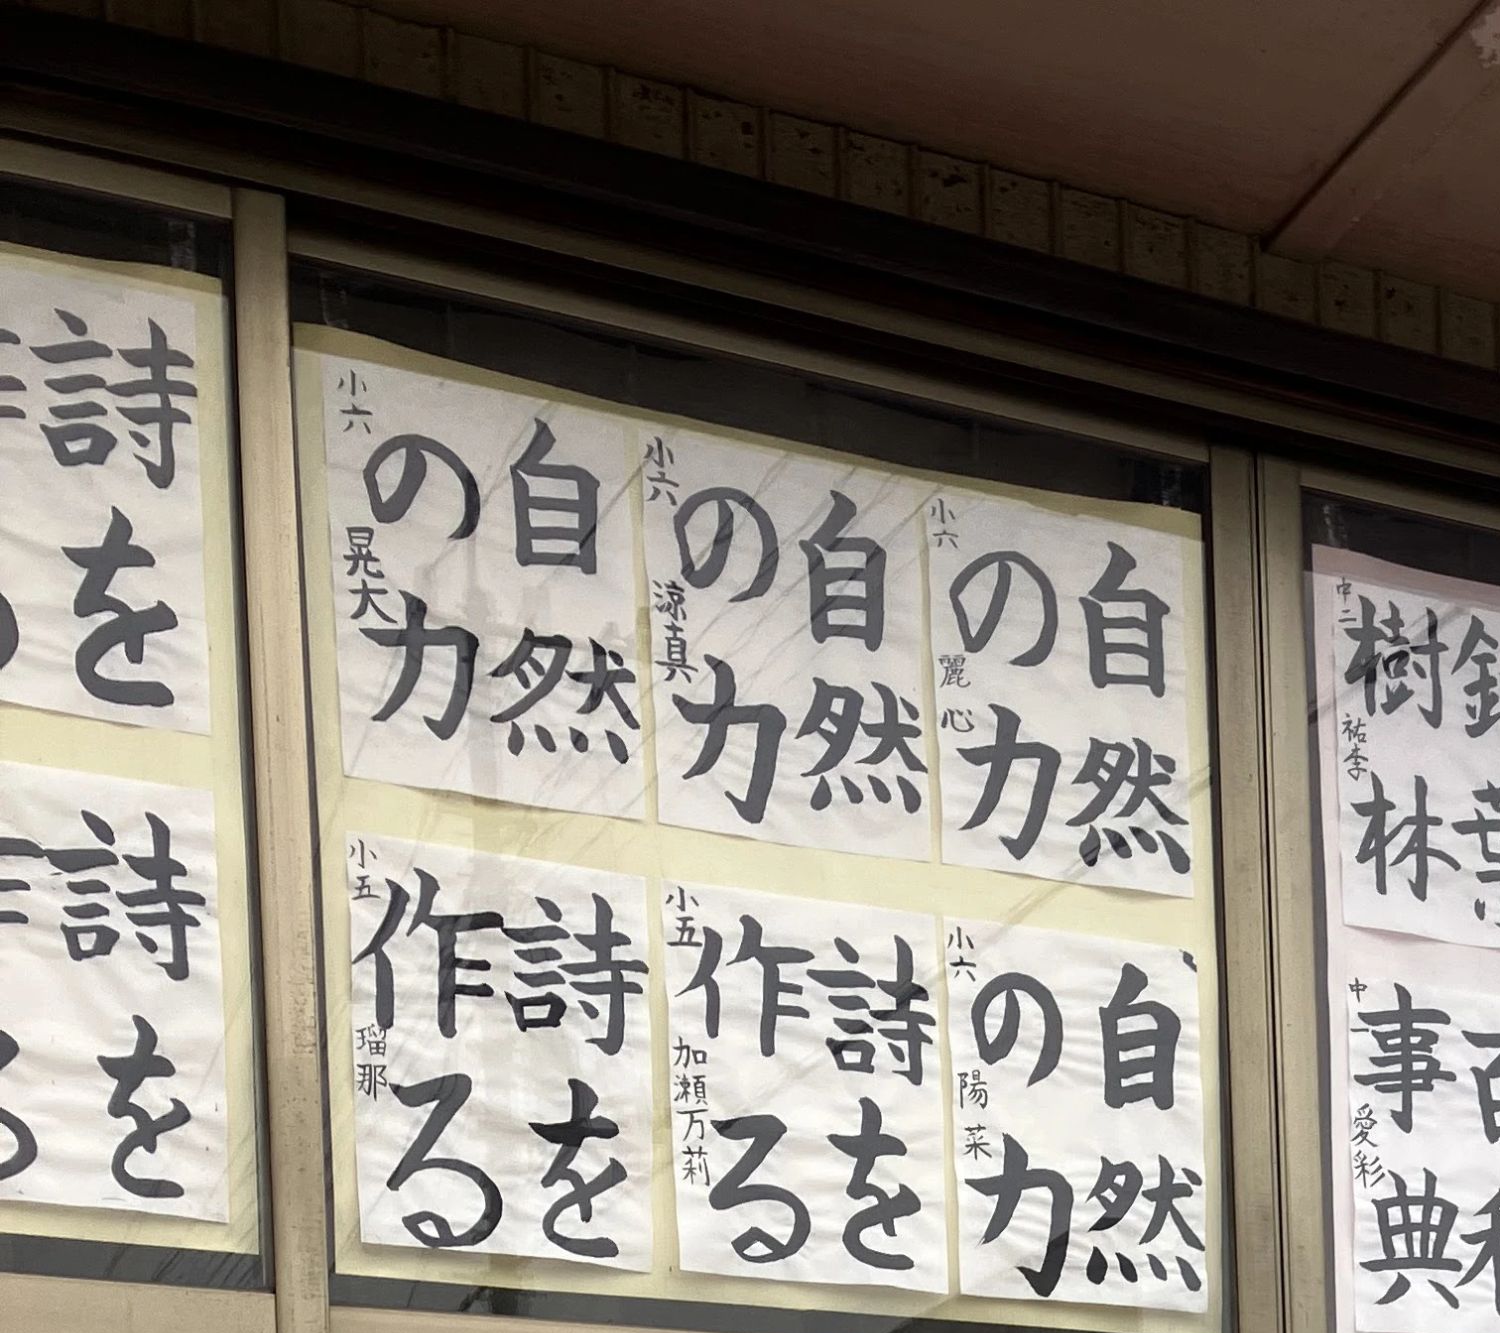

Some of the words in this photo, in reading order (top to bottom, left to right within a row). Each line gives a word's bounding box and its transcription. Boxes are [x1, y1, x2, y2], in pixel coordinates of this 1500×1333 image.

[29, 307, 199, 708] 詩を
[337, 369, 373, 435] 小六
[643, 436, 679, 507] 小六
[930, 498, 960, 551] 小六
[357, 433, 482, 741] の力
[488, 417, 642, 765] 自然
[672, 486, 788, 824] の力
[795, 489, 929, 813] 自然
[948, 550, 1062, 861] の力
[1065, 541, 1191, 874] 自然
[1336, 577, 1357, 623] 中二
[1344, 594, 1461, 901] 樹林
[45, 810, 206, 1199] 詩を
[347, 838, 382, 900] 小五
[666, 886, 703, 949] 小五
[948, 925, 977, 984] 小六
[352, 866, 503, 1248] 作る
[500, 893, 650, 1259] 詩を
[673, 914, 815, 1264] 作る
[805, 934, 937, 1272] 詩を
[964, 971, 1074, 1298] の力
[1085, 961, 1206, 1293] 自然
[1354, 982, 1463, 1309] 事典
